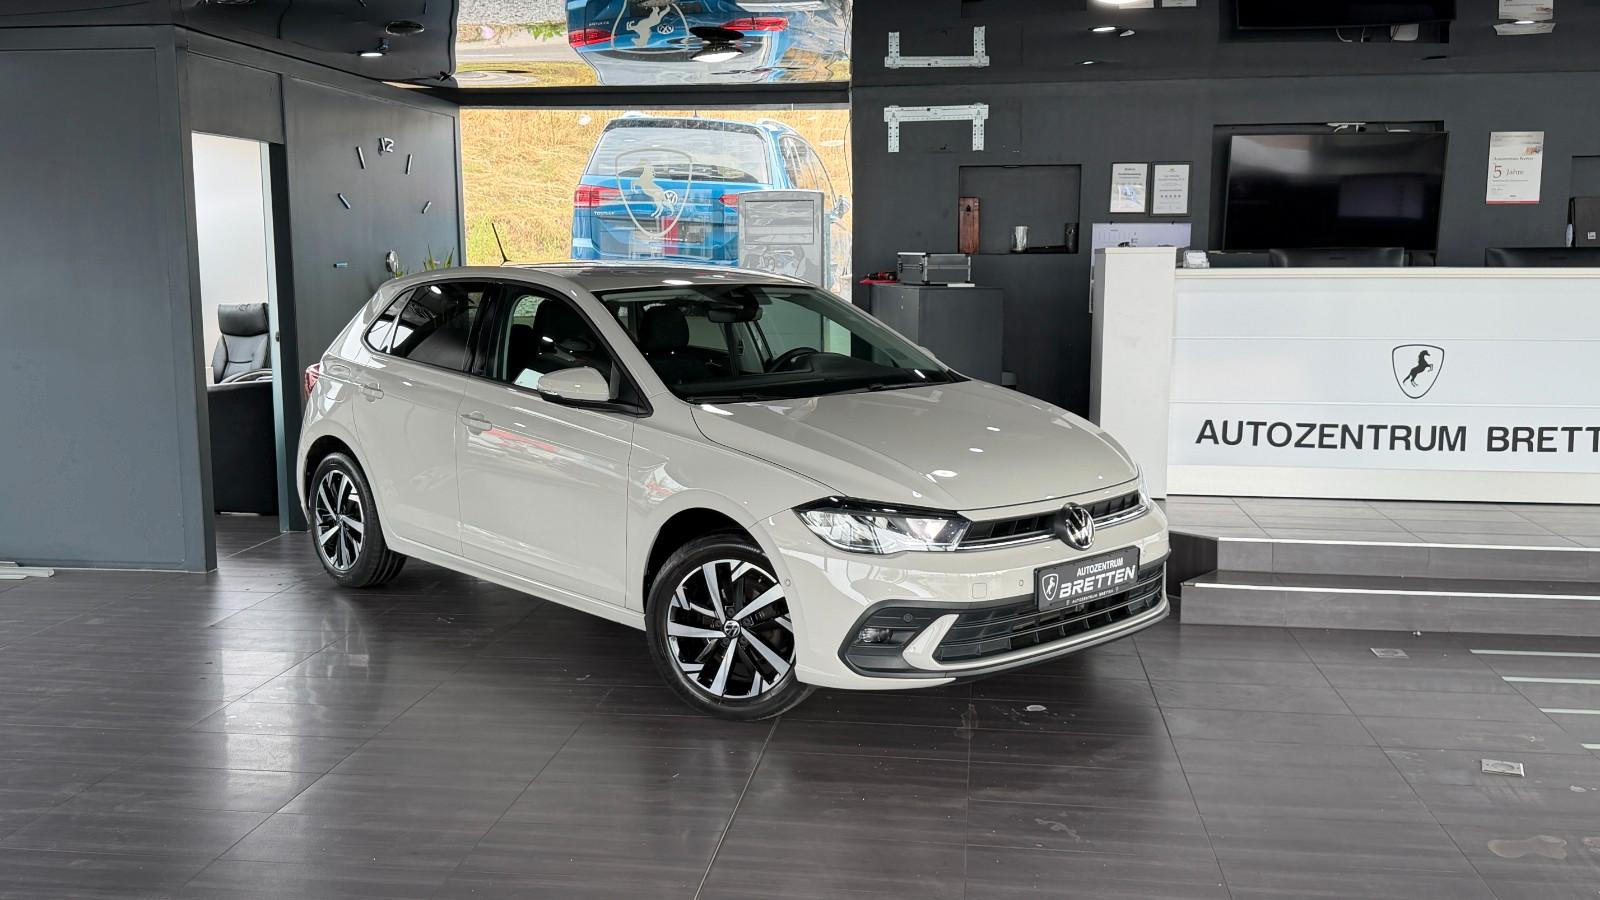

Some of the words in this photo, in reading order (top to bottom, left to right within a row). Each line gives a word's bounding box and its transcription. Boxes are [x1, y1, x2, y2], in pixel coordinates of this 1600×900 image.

[379, 137, 394, 152] 12
[1493, 165, 1502, 178] 5
[1196, 419, 1466, 452] AUTOZENTRUM
[1076, 557, 1124, 577] AUTOZENTRUM
[1059, 564, 1136, 599] BRETTEN
